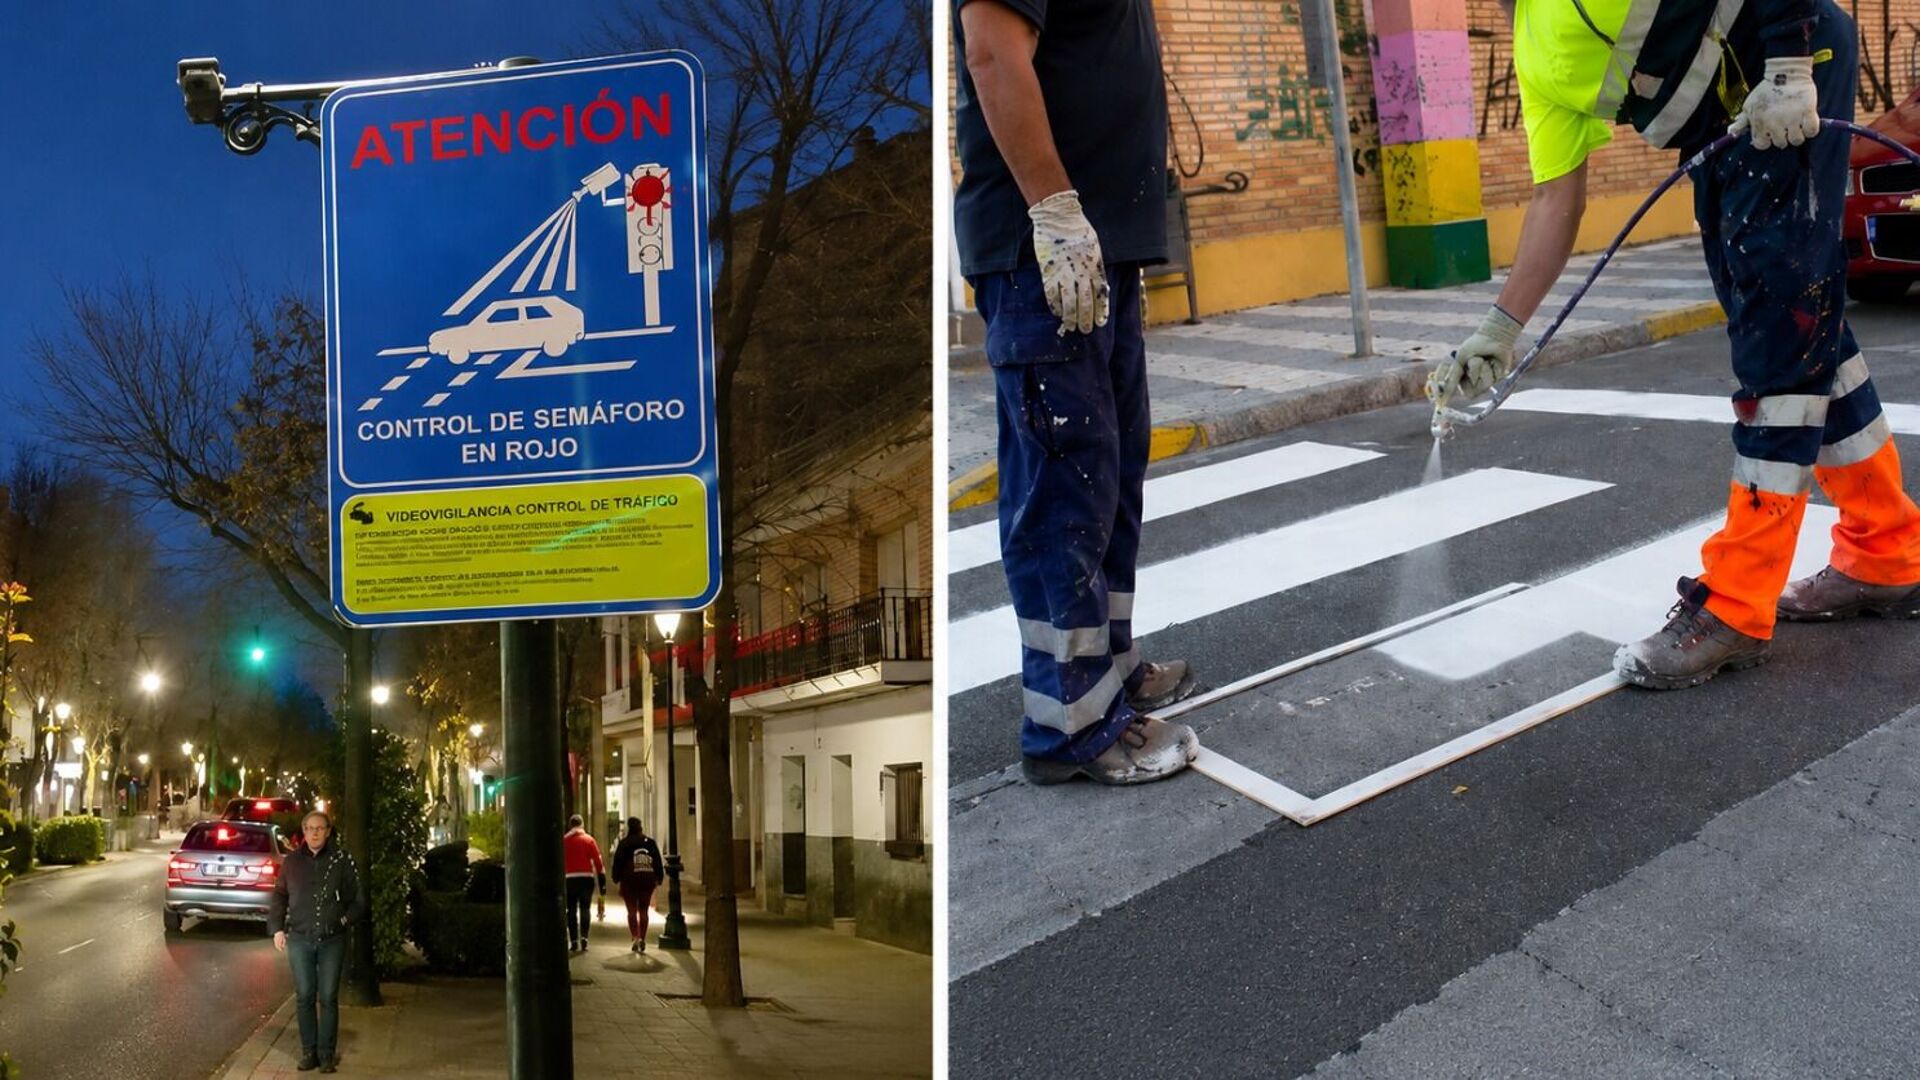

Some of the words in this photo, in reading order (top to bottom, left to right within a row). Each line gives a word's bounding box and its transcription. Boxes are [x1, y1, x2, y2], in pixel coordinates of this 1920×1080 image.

[351, 88, 672, 170] ATENCIÓN
[357, 413, 482, 442] CONTROL
[490, 410, 524, 433] DE
[533, 399, 686, 429] SEMÁFORO
[461, 442, 496, 464] EN
[506, 437, 579, 462] ROJO
[386, 505, 512, 523] VIDEOVIGILANCIA
[516, 500, 586, 516] CONTROL
[591, 499, 609, 511] DE
